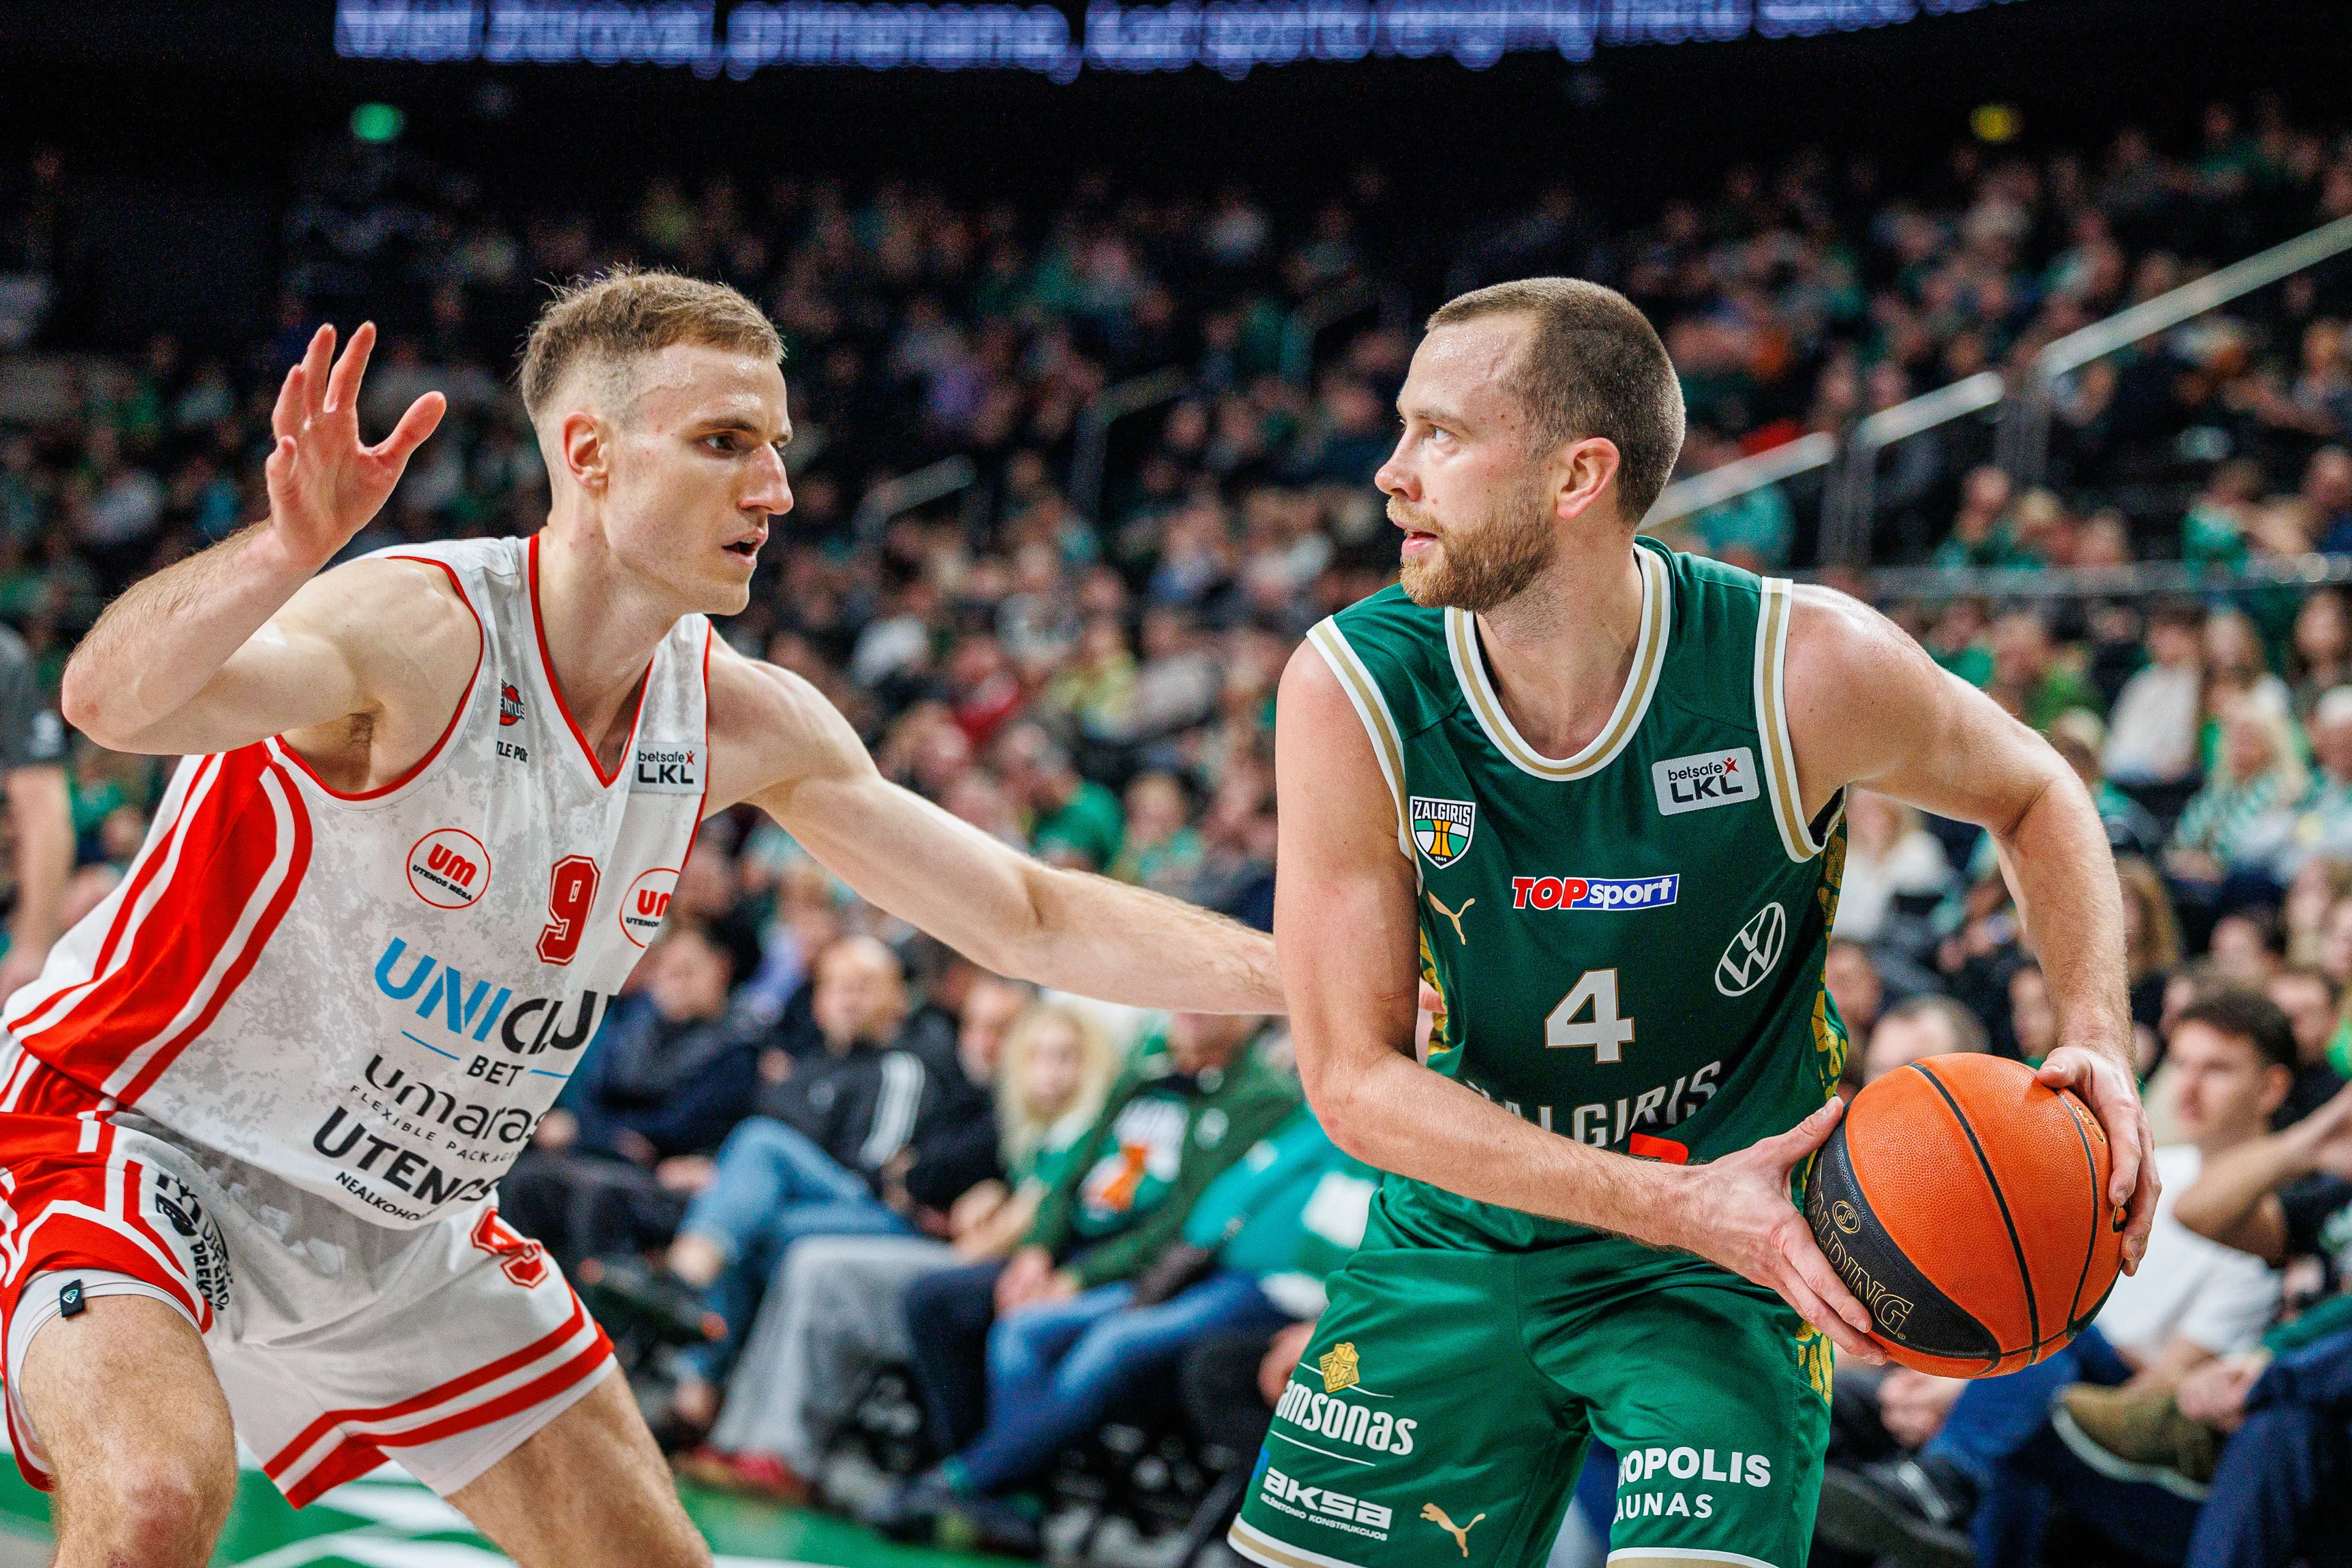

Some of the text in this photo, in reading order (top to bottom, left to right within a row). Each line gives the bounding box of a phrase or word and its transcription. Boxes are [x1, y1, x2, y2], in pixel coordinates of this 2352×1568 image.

[638, 750, 685, 762] betsafe
[1668, 762, 1722, 781] betsafe
[638, 764, 694, 783] LKL
[1670, 774, 1743, 804] LKL
[412, 864, 448, 887] UTENOS
[536, 855, 600, 966] 9
[1545, 968, 1635, 1064] 4
[467, 1055, 524, 1087] BET
[350, 1085, 436, 1141] FLEXIBLE
[1613, 1492, 1714, 1524] AUNAS
